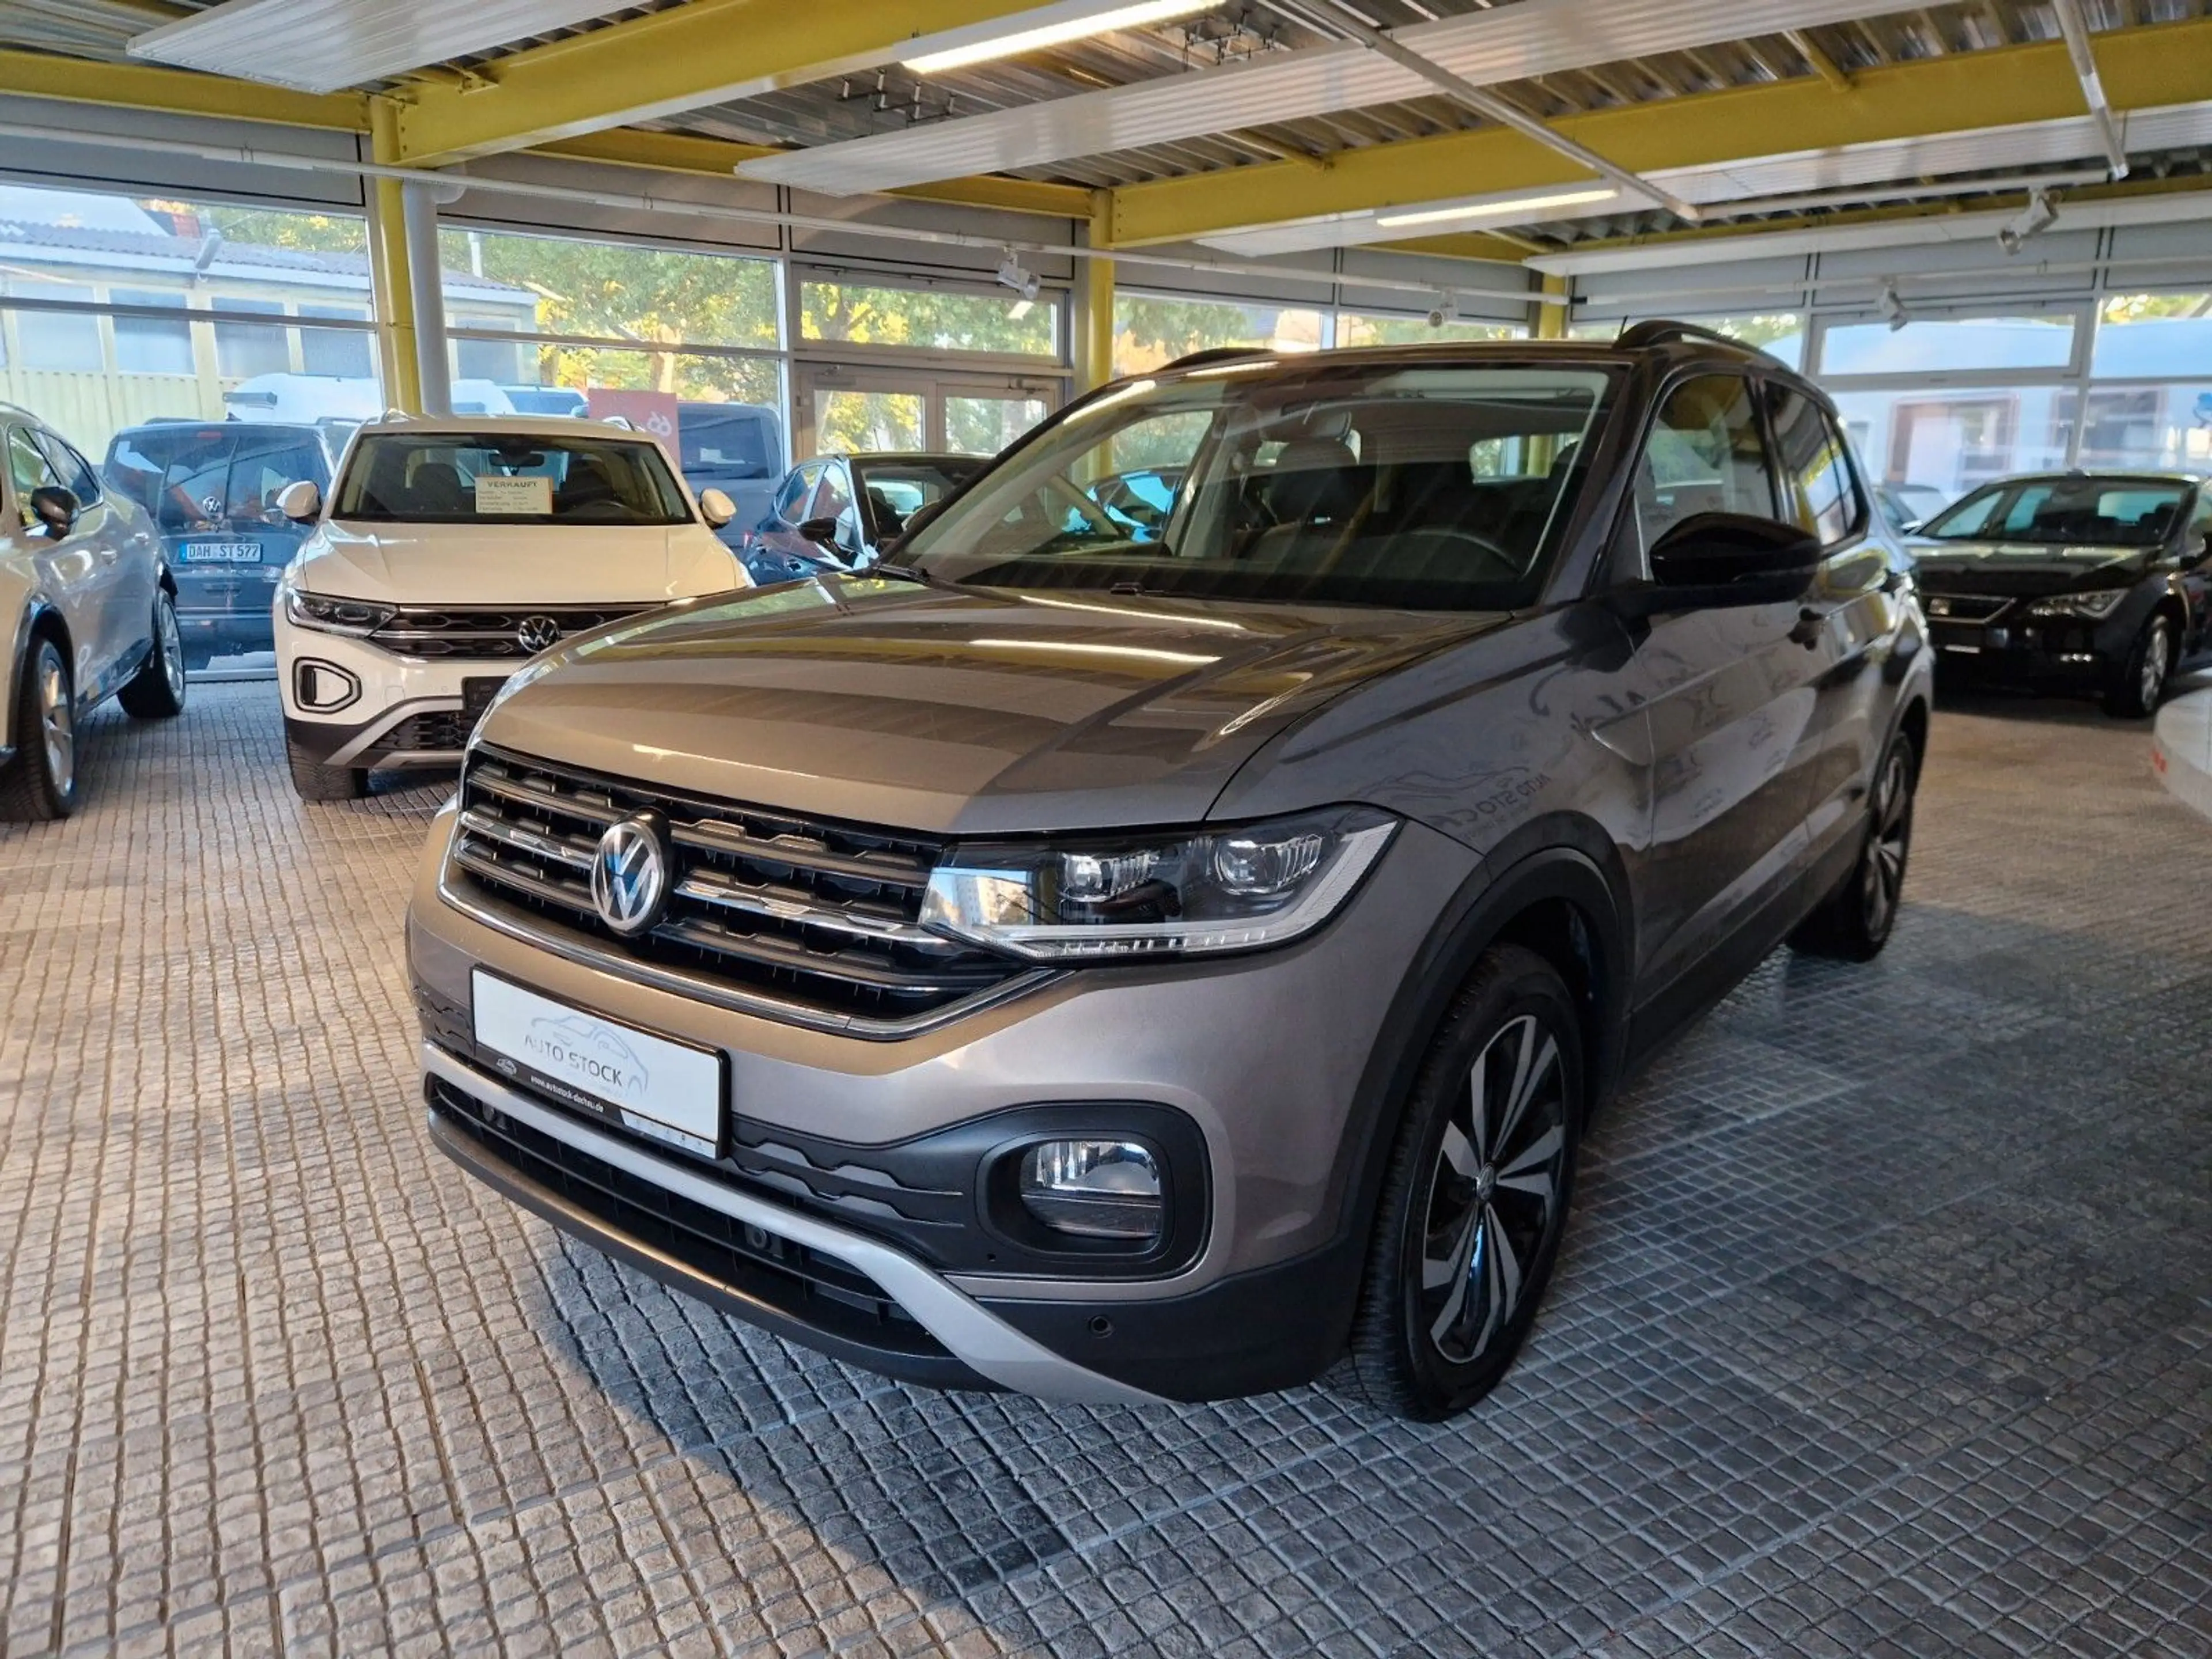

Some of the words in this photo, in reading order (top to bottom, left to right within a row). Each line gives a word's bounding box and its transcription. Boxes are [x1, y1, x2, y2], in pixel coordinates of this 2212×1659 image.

[189, 546, 210, 557] DAH
[220, 546, 234, 557] ST
[237, 546, 259, 557] 577
[525, 1034, 563, 1061] AUTO
[569, 1052, 623, 1087] STOCK
